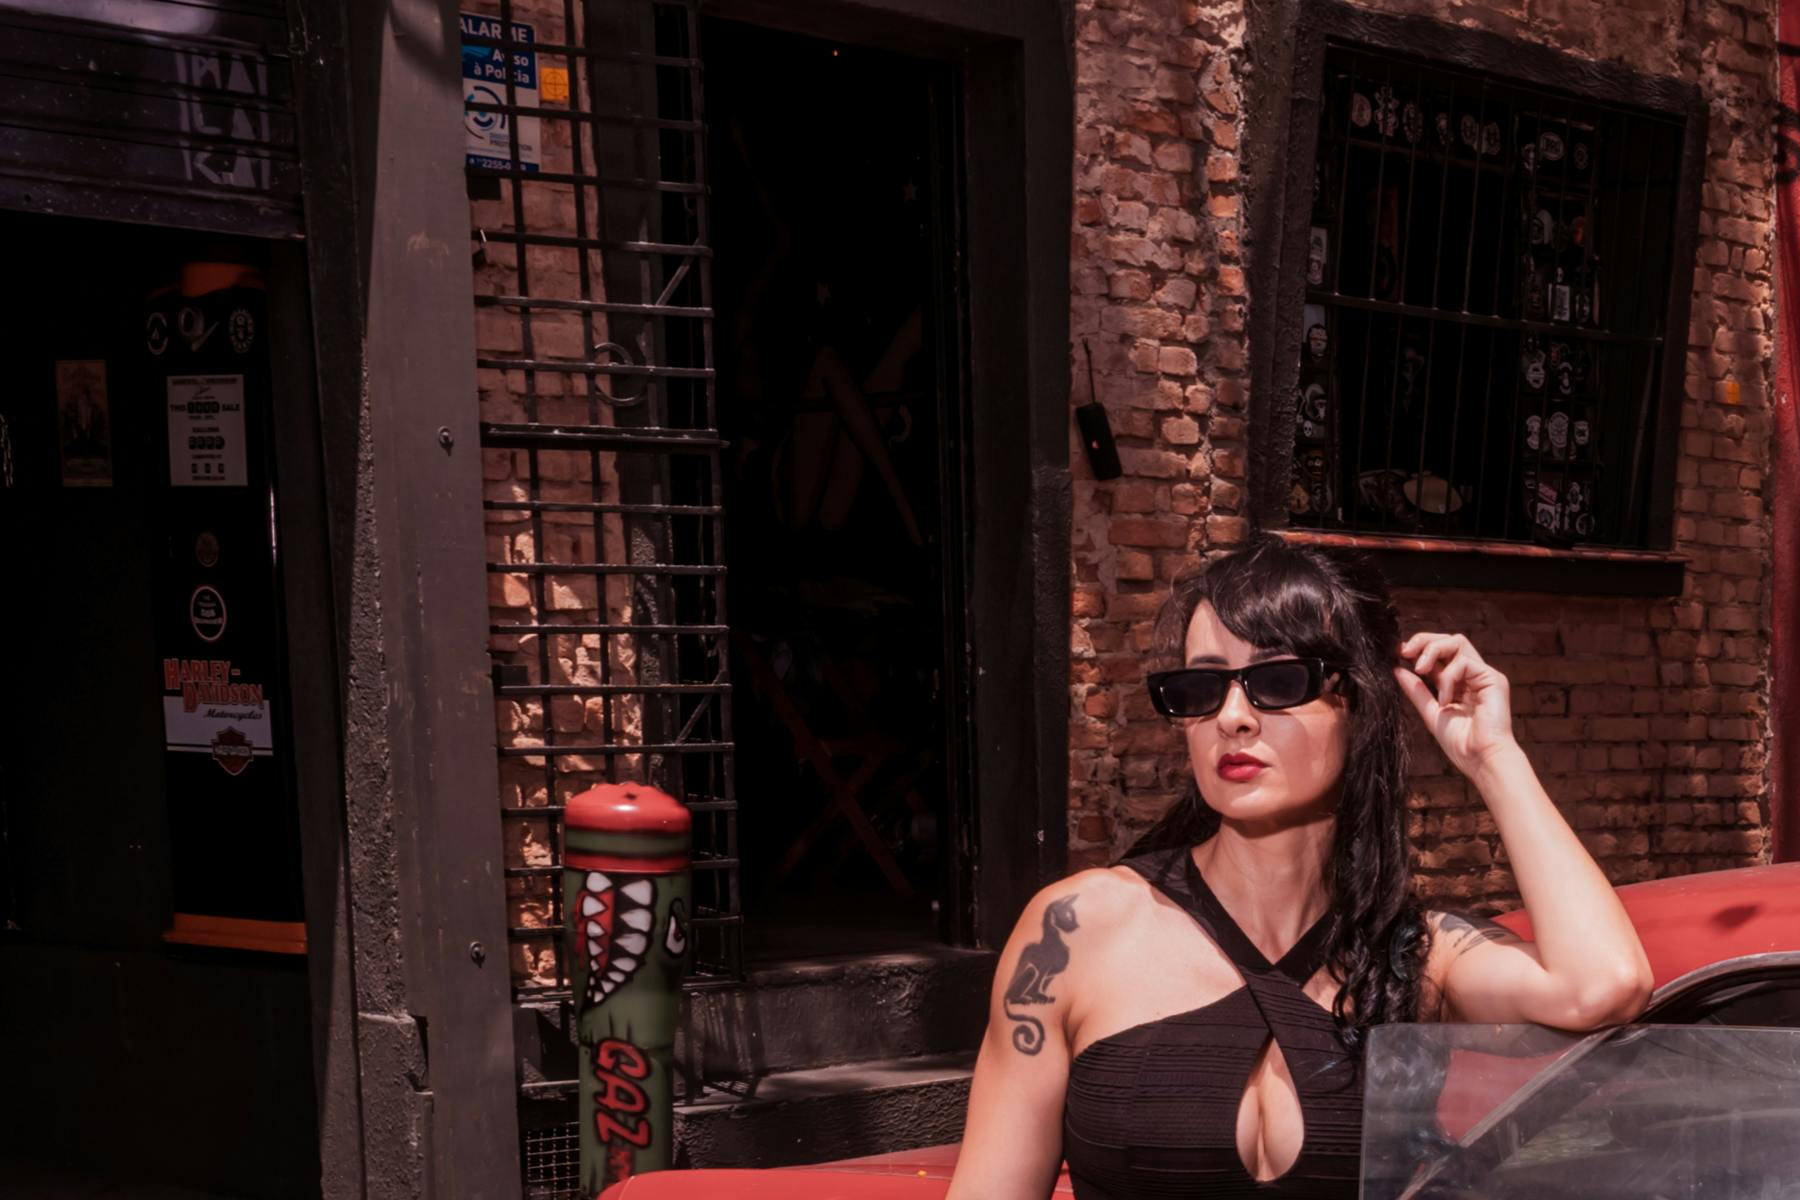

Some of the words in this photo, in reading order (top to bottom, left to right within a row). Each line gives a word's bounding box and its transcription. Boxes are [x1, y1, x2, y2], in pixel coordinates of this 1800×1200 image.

[163, 657, 241, 690] HARLEY-
[183, 681, 264, 713] DAVIDSON
[203, 708, 263, 721] Motorcycles
